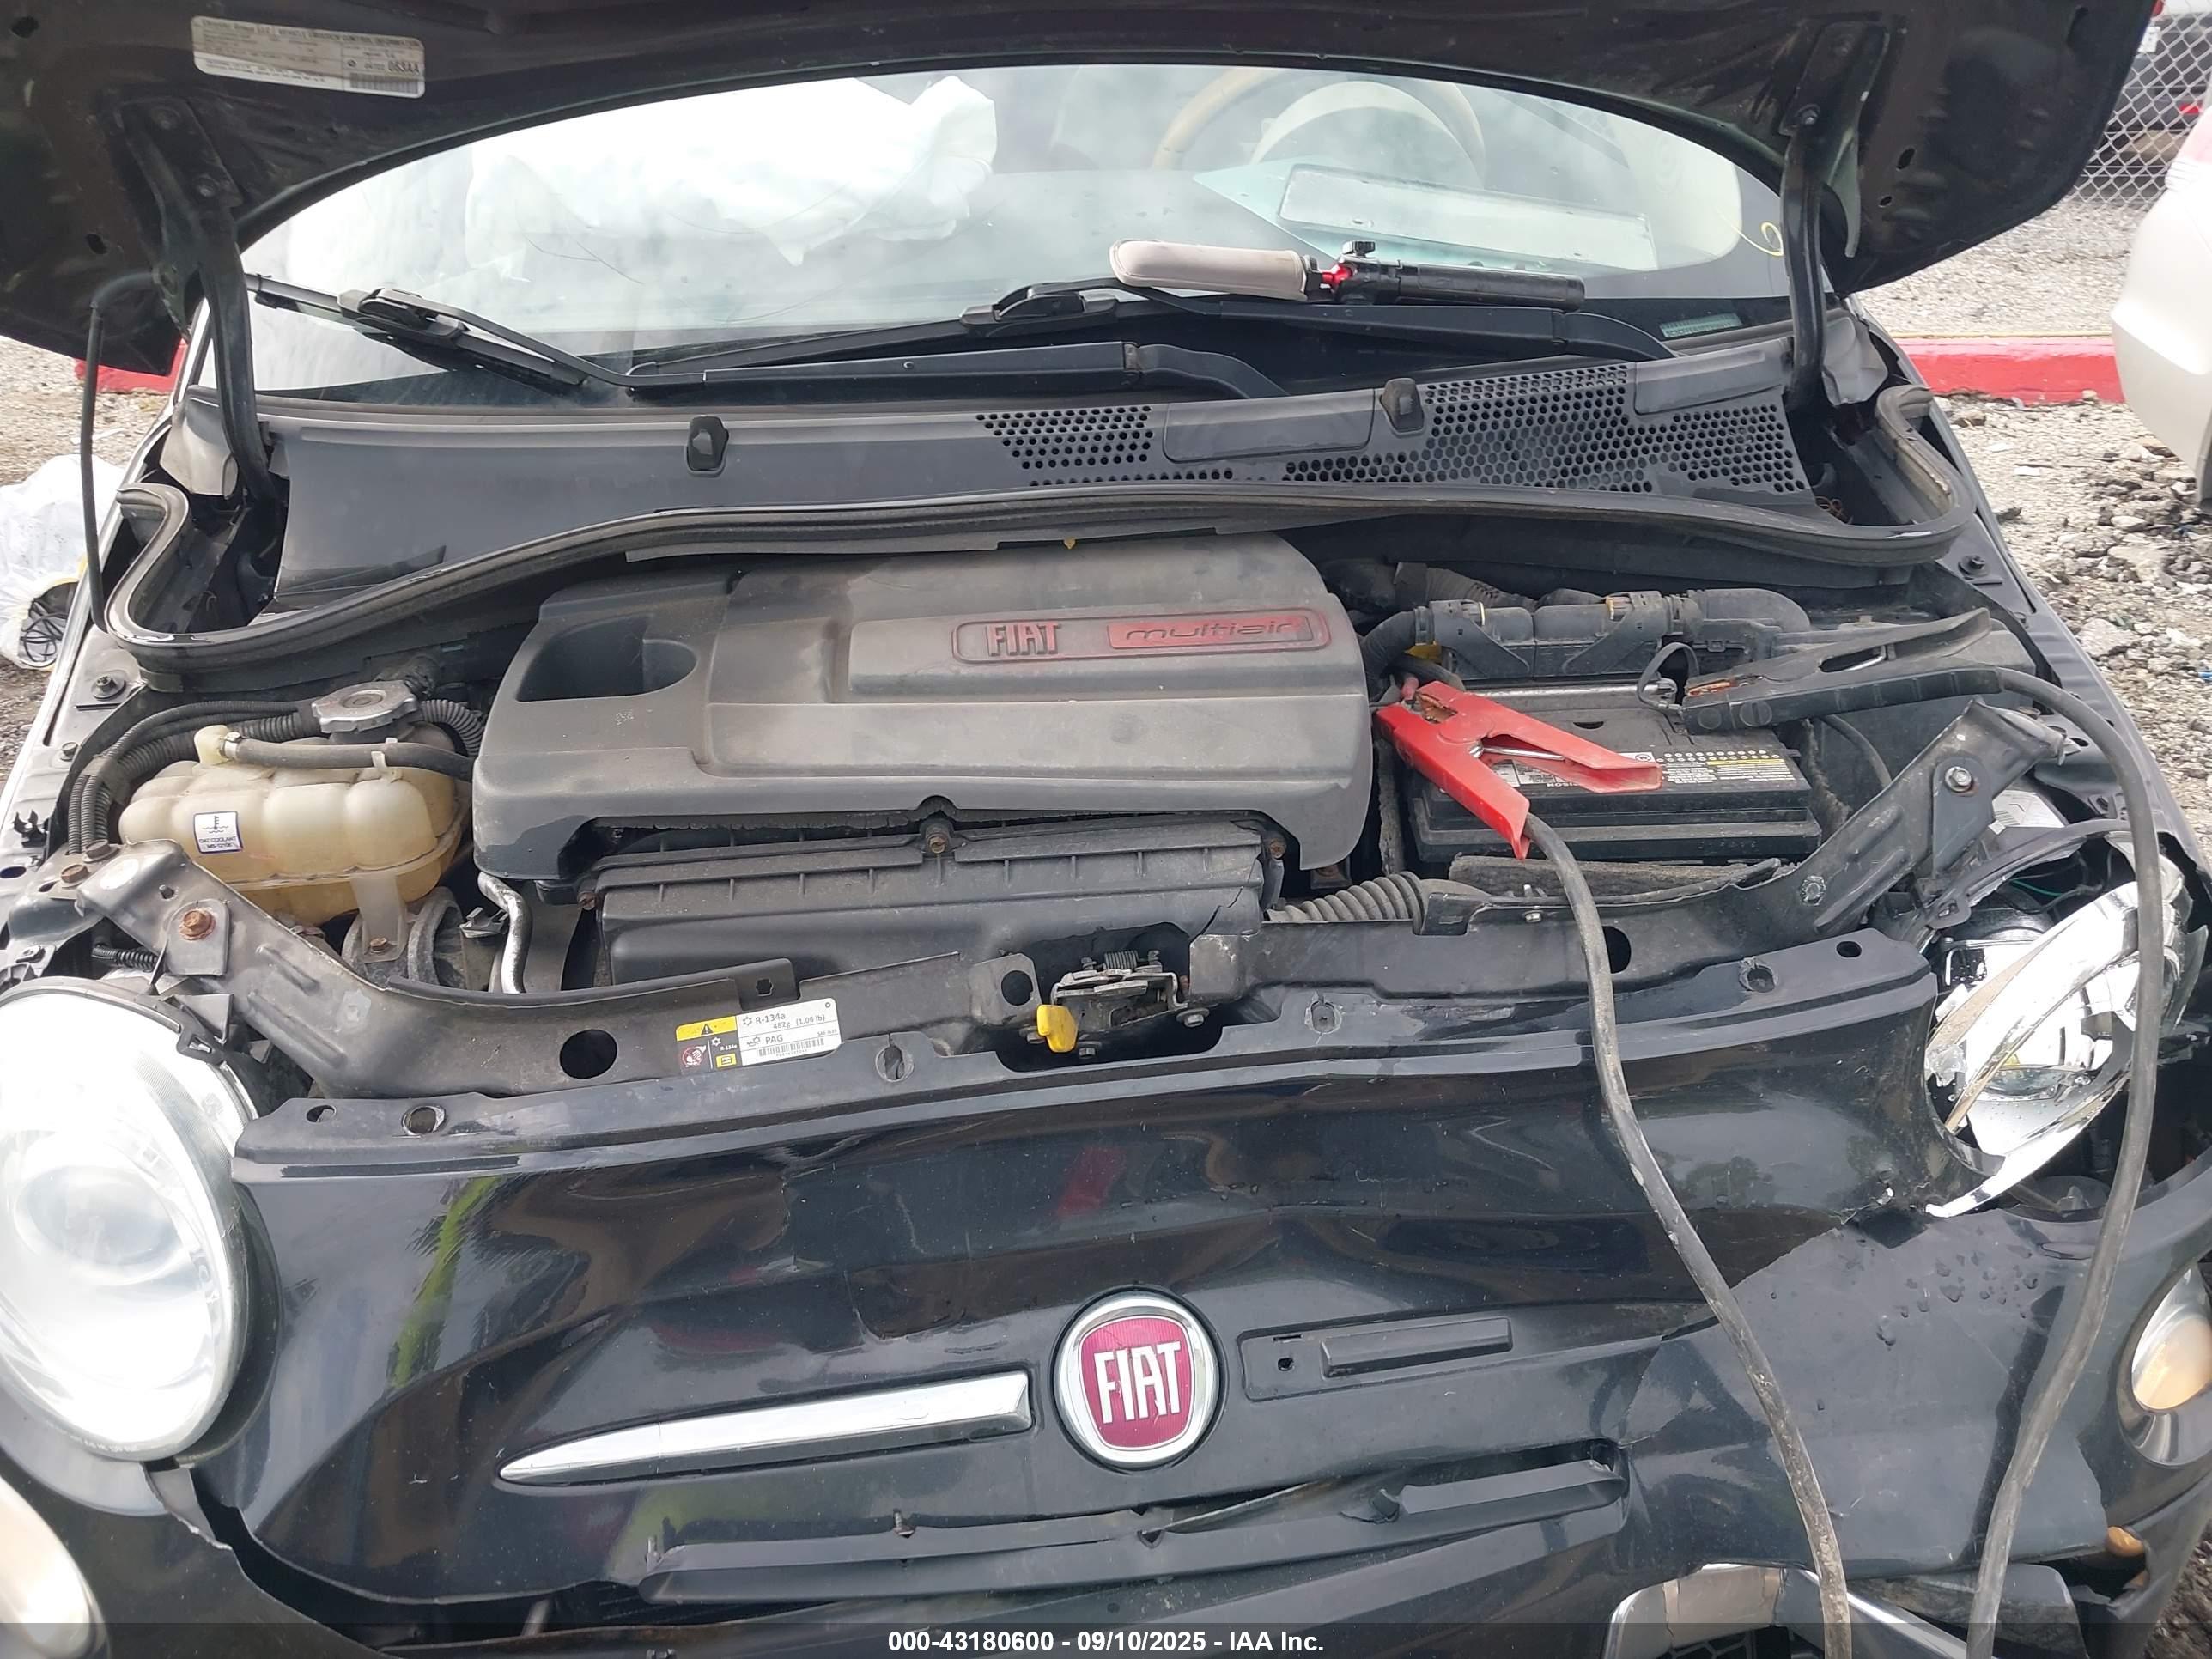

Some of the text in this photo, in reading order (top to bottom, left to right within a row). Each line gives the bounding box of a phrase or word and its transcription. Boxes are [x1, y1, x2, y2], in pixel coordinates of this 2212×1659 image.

[986, 620, 1295, 657] FIAT multiair
[756, 1013, 786, 1024] R-134a
[765, 1035, 783, 1044] PAG
[1093, 1340, 1182, 1425] FIAT
